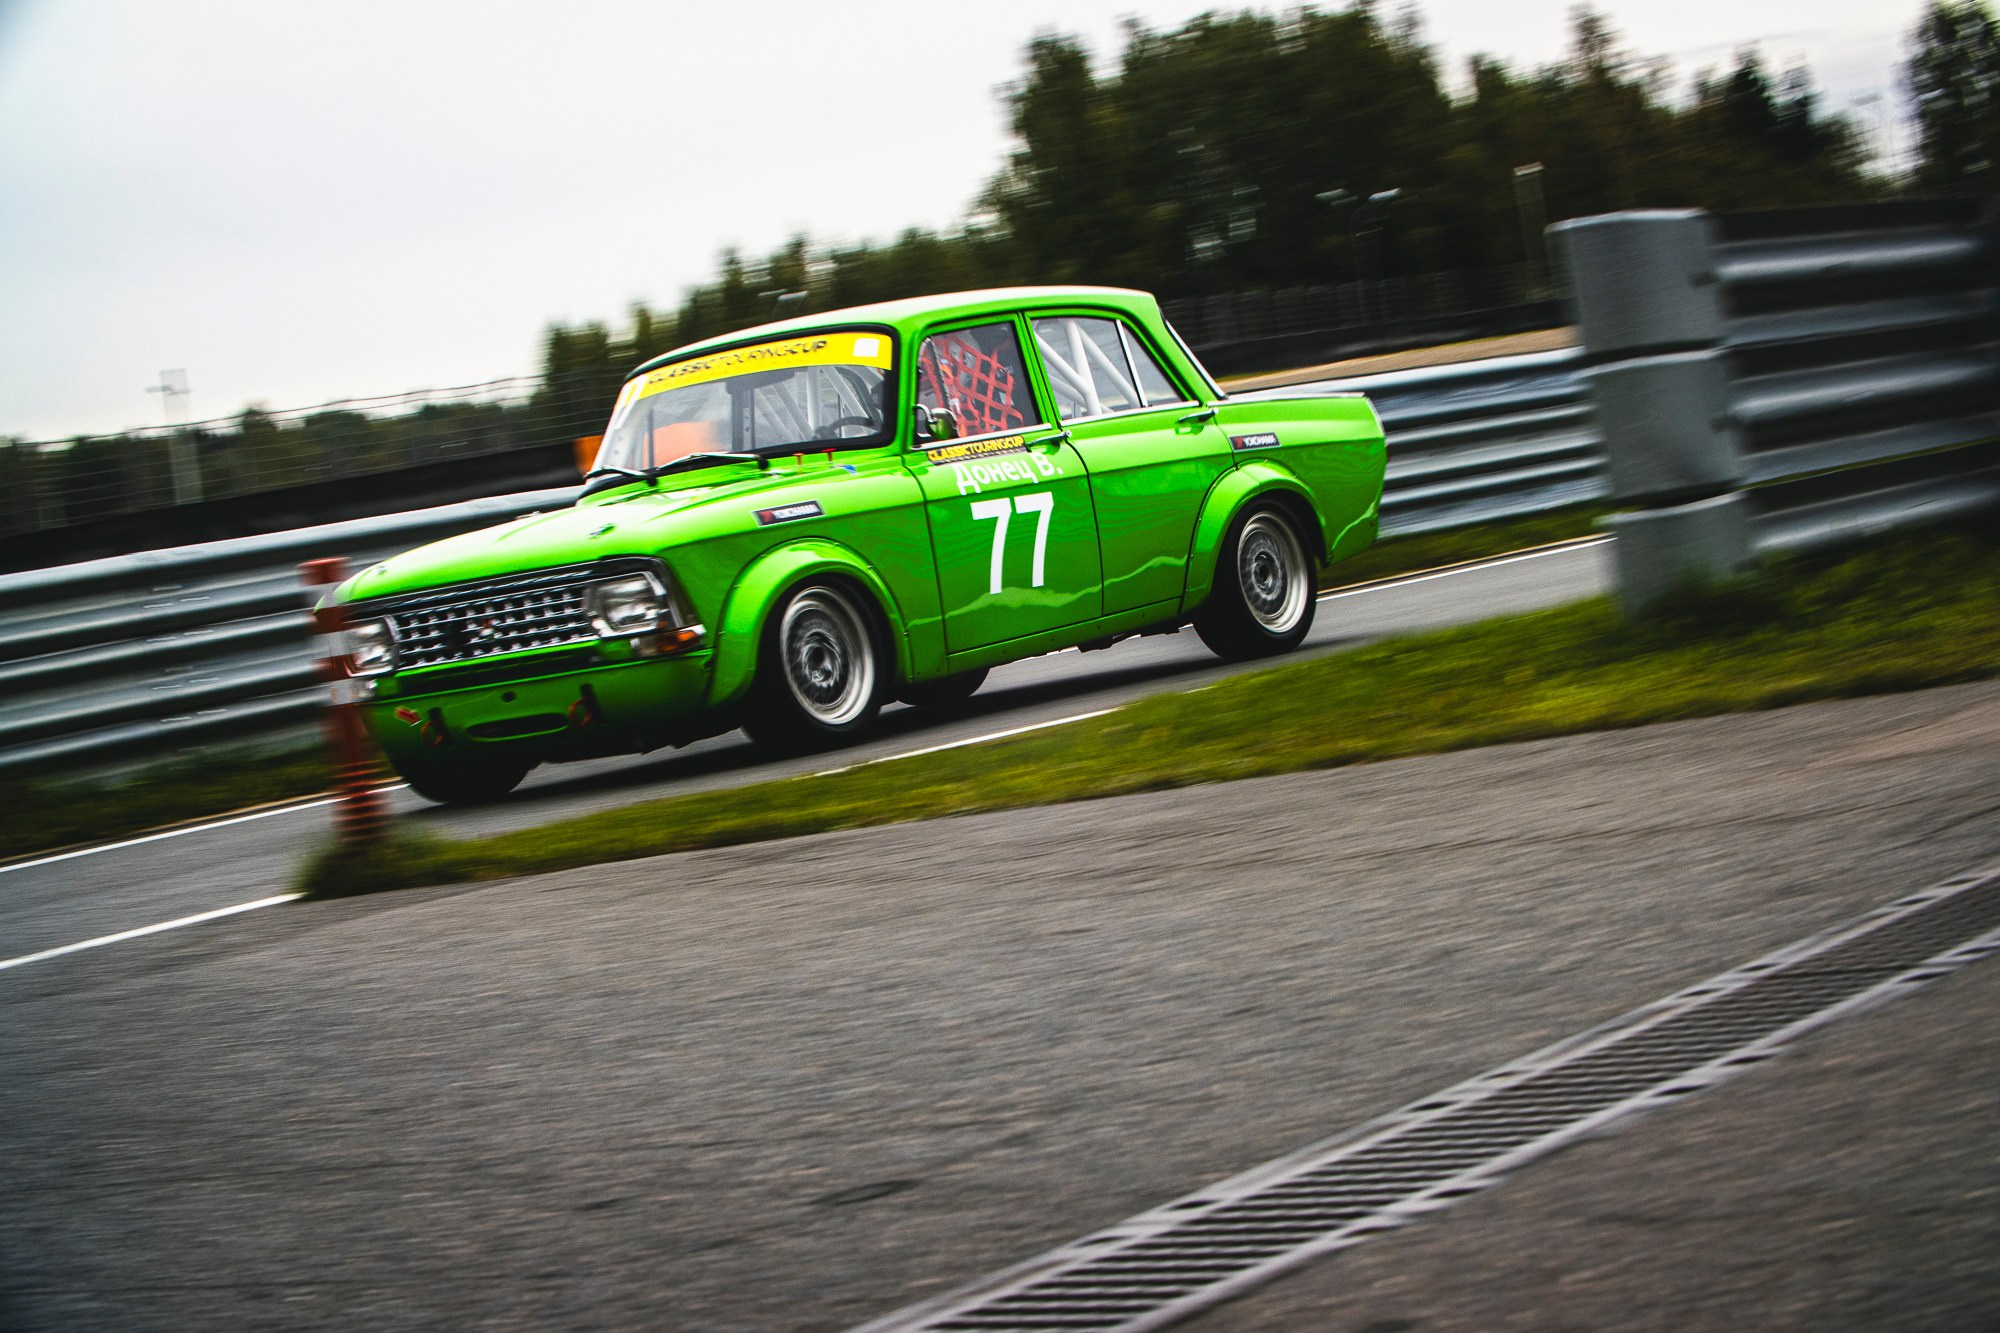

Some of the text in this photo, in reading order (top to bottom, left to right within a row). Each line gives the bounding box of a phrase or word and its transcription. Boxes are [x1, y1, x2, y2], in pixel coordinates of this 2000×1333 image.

[927, 435, 1025, 462] CLASSICTOURINGCUP
[951, 451, 1064, 496] Донец В.
[970, 491, 1055, 595] 77
